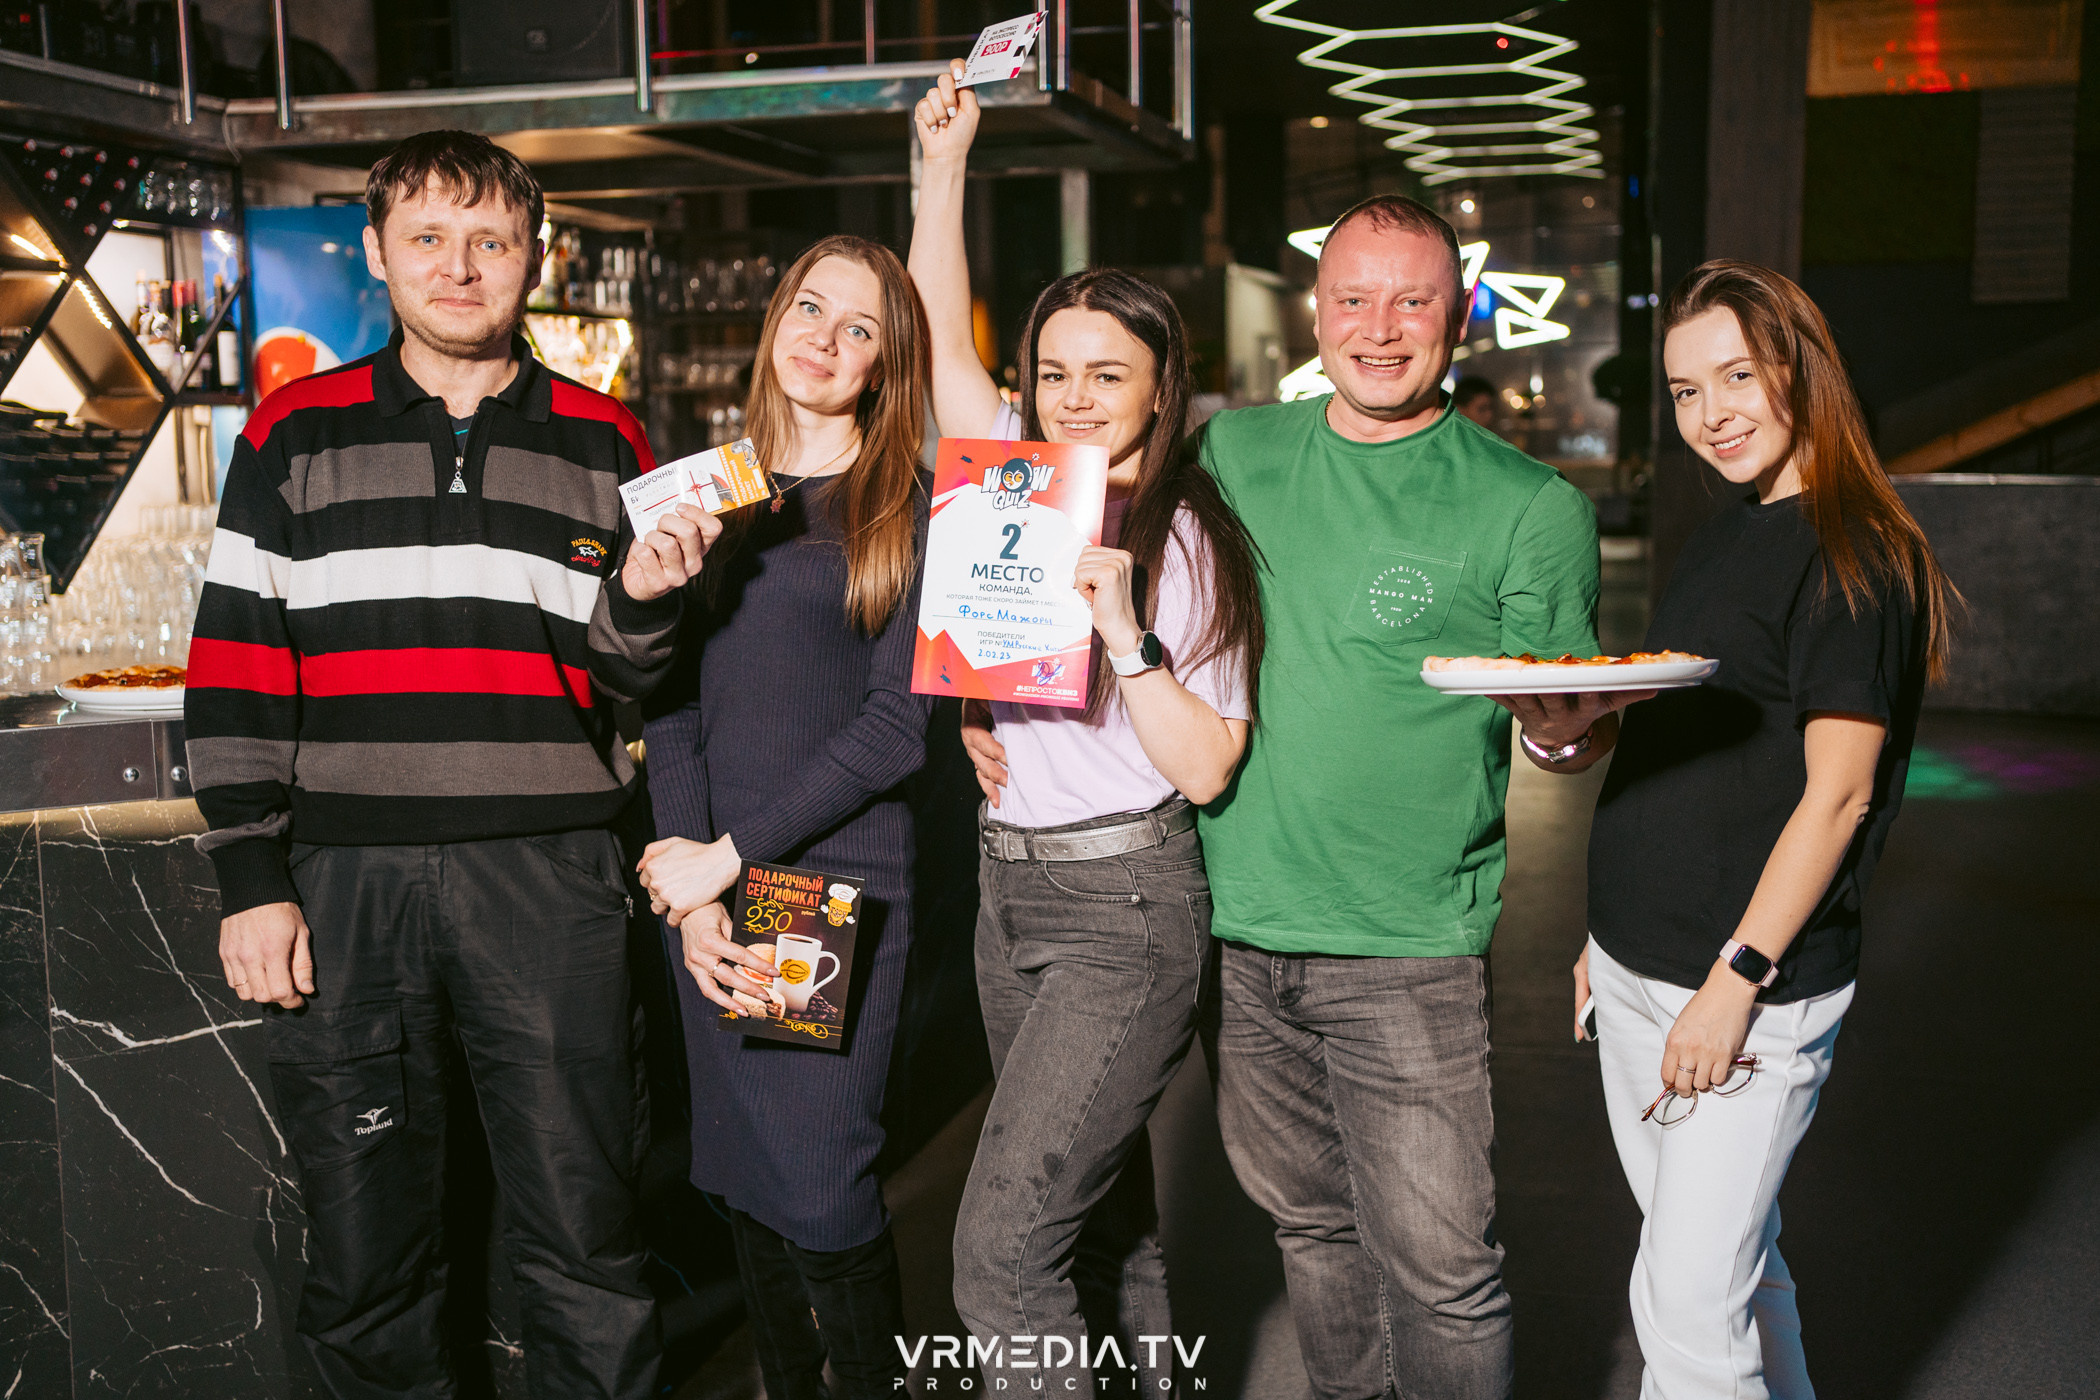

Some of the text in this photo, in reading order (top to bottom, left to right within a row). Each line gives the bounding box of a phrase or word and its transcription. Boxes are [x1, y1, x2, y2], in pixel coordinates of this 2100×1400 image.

[626, 467, 678, 494] ПОДАРОЧНЫ
[981, 458, 1056, 493] WOW
[992, 489, 1031, 510] QUIZ
[999, 523, 1022, 560] 2
[970, 563, 1045, 583] МЕСТО
[1373, 565, 1434, 594] ESTABLISHED
[946, 593, 974, 601] КОТОРАЯ
[1369, 588, 1433, 604] MANGO MAN
[958, 604, 994, 619] Форс
[1370, 599, 1426, 627] BARCELONA
[977, 630, 1026, 640] ПОБЕДИТЕЛИ
[748, 867, 824, 893] ПОДАРОЧНЫЙ
[746, 882, 822, 908] СЕРТИФИКАТ
[744, 905, 793, 932] 250
